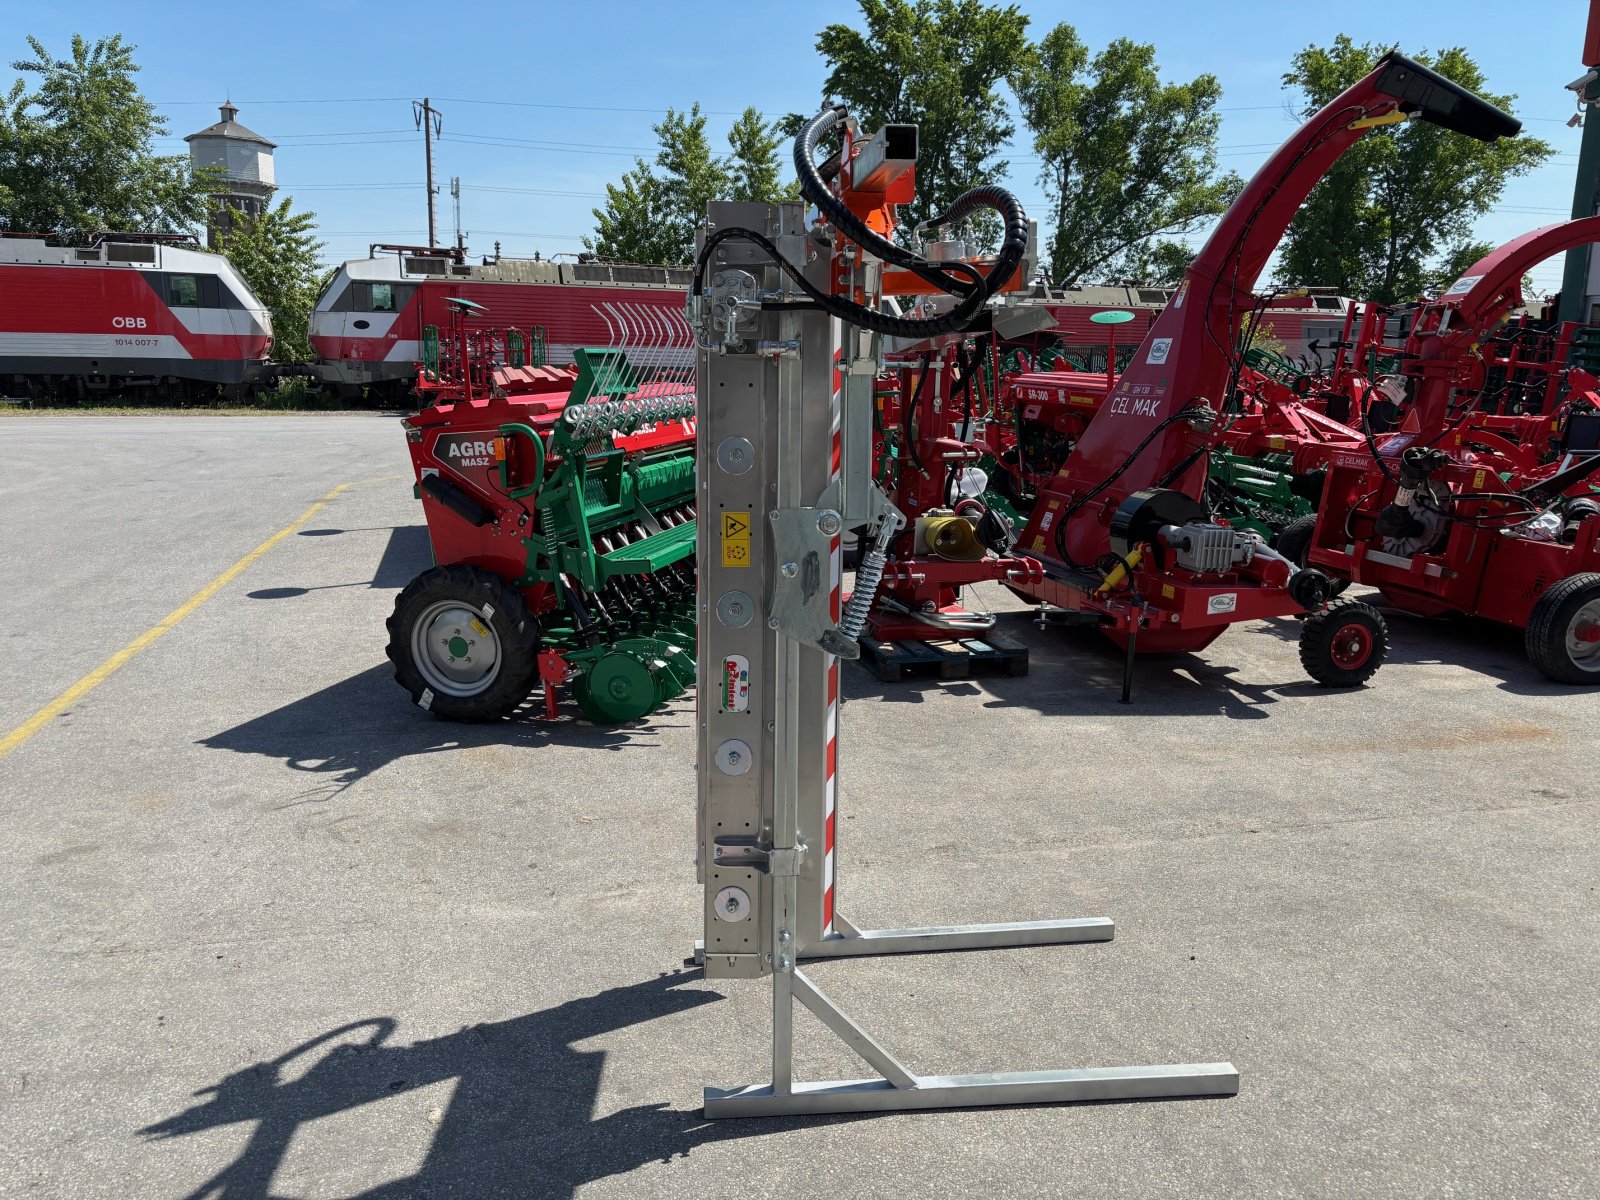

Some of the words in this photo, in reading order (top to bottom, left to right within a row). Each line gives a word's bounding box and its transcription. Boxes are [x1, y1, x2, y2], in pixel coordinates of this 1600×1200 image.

[112, 316, 147, 328] ÖBB
[1028, 389, 1048, 401] SR-300
[1131, 398, 1161, 417] MAK
[461, 457, 489, 467] MASZ
[1345, 456, 1368, 467] CELMAK
